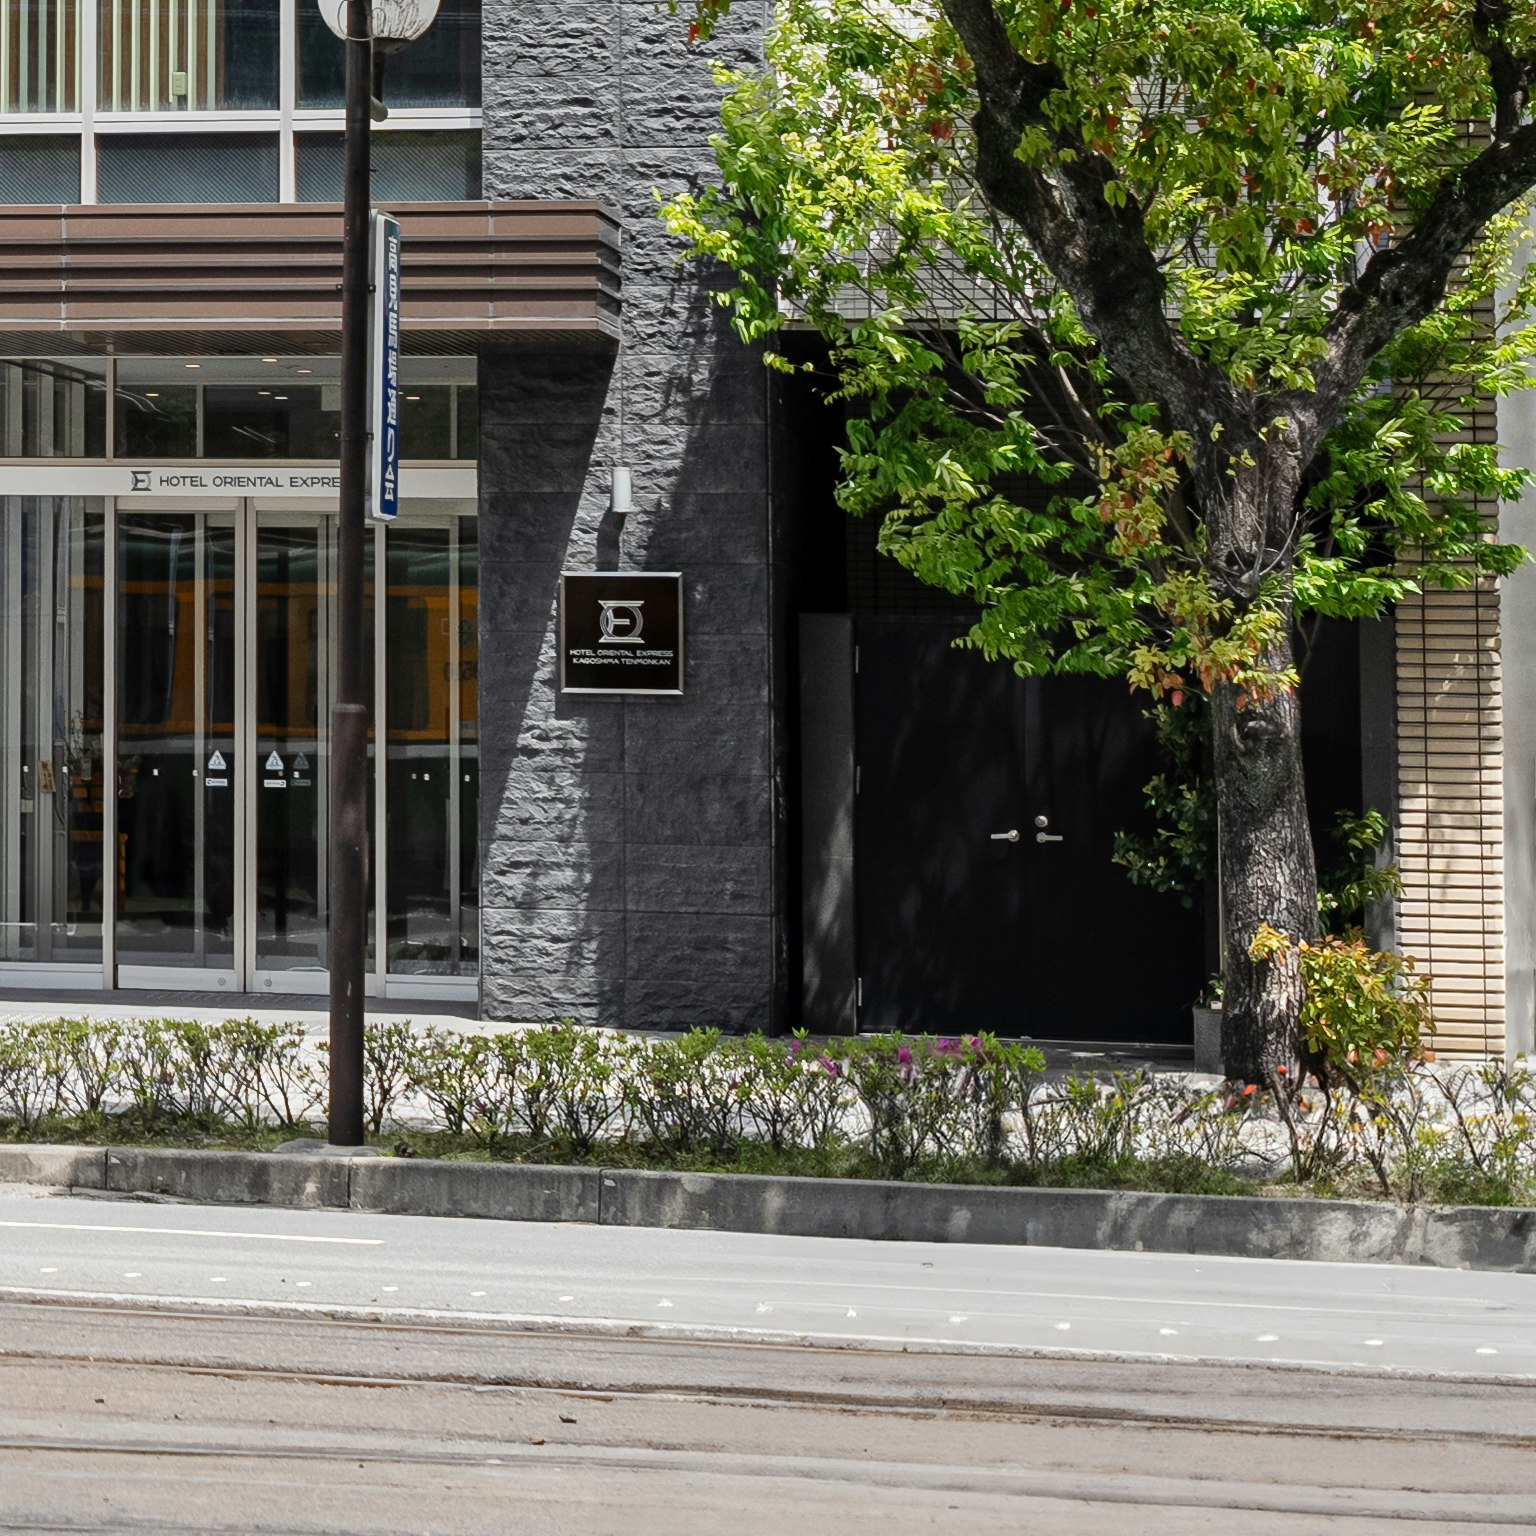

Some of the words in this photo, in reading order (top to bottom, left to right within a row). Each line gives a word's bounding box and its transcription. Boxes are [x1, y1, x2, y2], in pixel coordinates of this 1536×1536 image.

[159, 476, 208, 488] HOTEL
[212, 476, 284, 488] ORIENTAL
[289, 476, 340, 488] EXPRE
[597, 649, 634, 657] ORIENTAL
